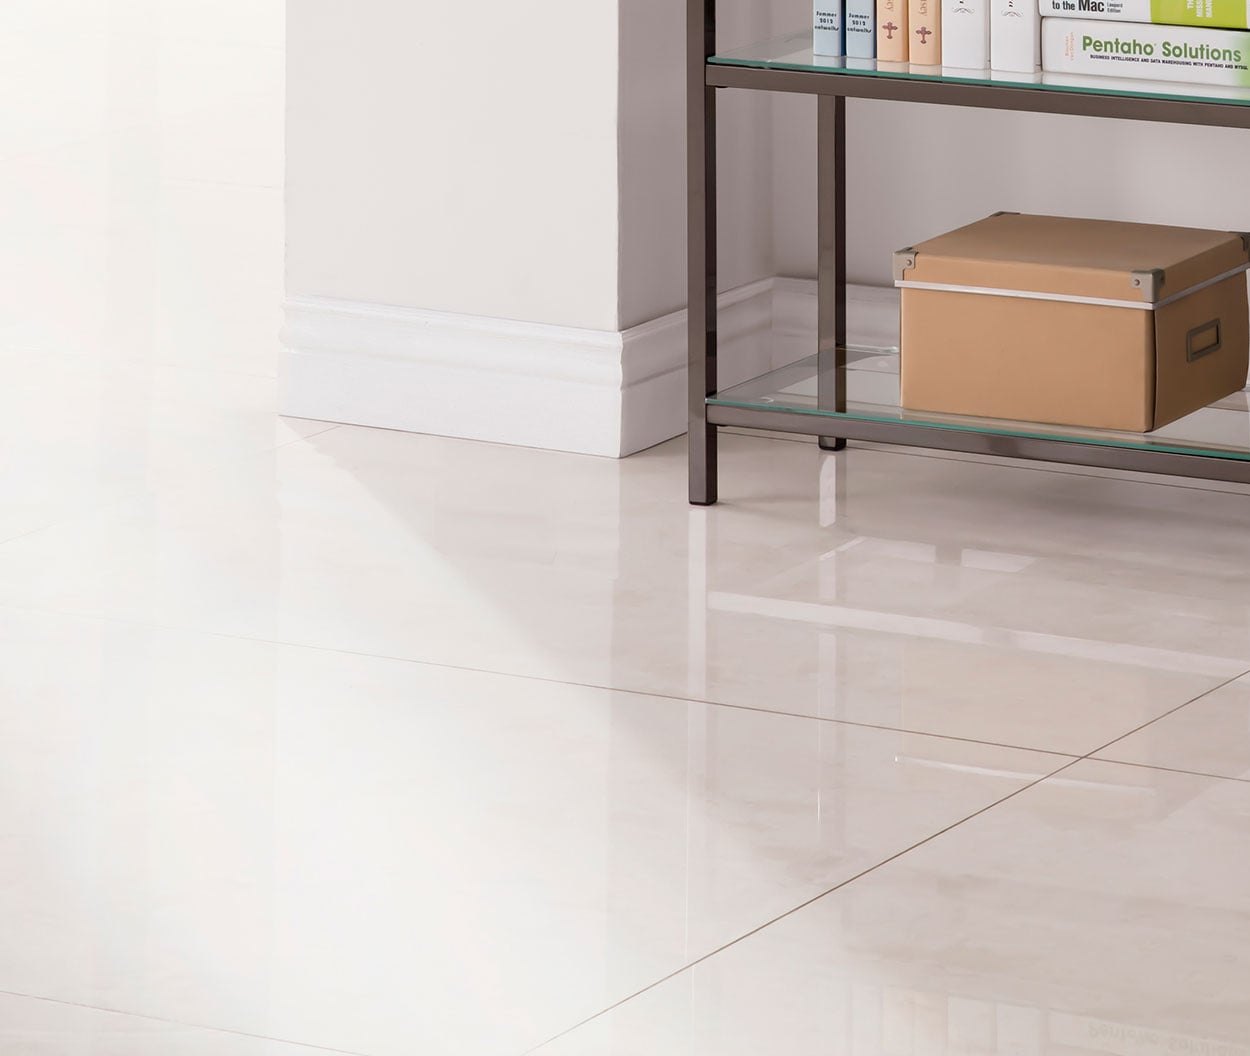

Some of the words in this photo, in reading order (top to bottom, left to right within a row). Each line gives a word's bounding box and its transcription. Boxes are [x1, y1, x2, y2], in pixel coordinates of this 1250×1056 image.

[1052, 0, 1060, 10] to
[1062, 1, 1075, 10] the
[1082, 35, 1154, 56] Pentaho
[1162, 41, 1242, 62] Solutions
